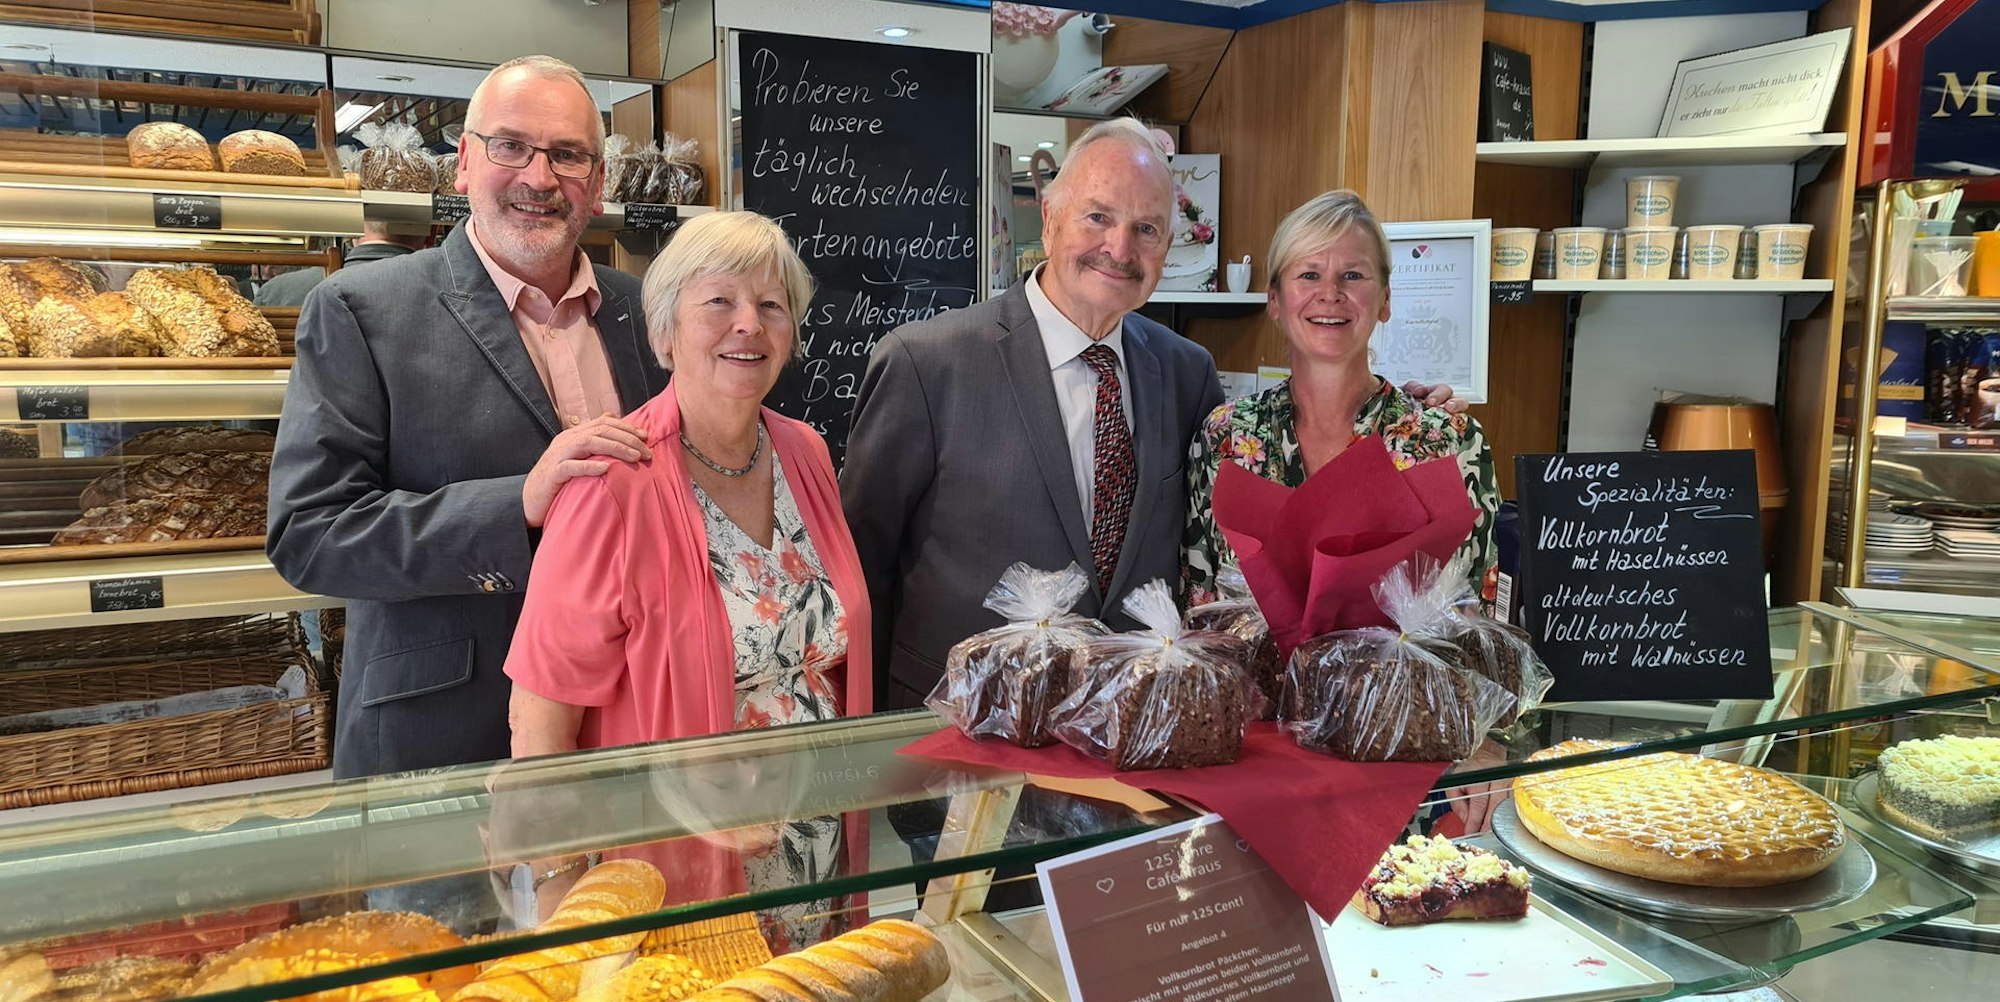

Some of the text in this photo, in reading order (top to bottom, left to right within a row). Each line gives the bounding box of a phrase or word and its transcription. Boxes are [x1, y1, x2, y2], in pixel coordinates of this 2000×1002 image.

[753, 47, 921, 106] Probieren Sie
[1738, 79, 1770, 92] macht
[1771, 73, 1798, 87] nicht
[1931, 71, 2000, 117] M
[809, 112, 885, 134] unsere
[752, 137, 858, 192] täglich
[810, 168, 971, 207] wechselnden
[1543, 456, 1620, 483] Unsere
[1577, 475, 1736, 514] Spezialitäten:
[1537, 511, 1670, 550] Vollkornbrot
[1572, 545, 1729, 572] mit Haselnüssen
[1542, 580, 1678, 609] altdeutsches
[1543, 610, 1688, 642] Vollkornbrot
[1581, 644, 1619, 666] mit
[1144, 853, 1174, 872] 125
[1146, 860, 1222, 890] Café raus
[1146, 895, 1245, 935] Für nur 125 Cent!
[1181, 930, 1227, 952] Angebot 4
[1158, 961, 1216, 986] Vollkornbrot
[1164, 984, 1181, 996] mit
[1182, 974, 1219, 991] unseren
[1220, 963, 1250, 979] beiden
[1251, 943, 1302, 968] Vollkornbrot
[1240, 962, 1292, 985] Vollkornbrot
[1293, 954, 1310, 966] und
[1250, 973, 1296, 995] Hausrezept
